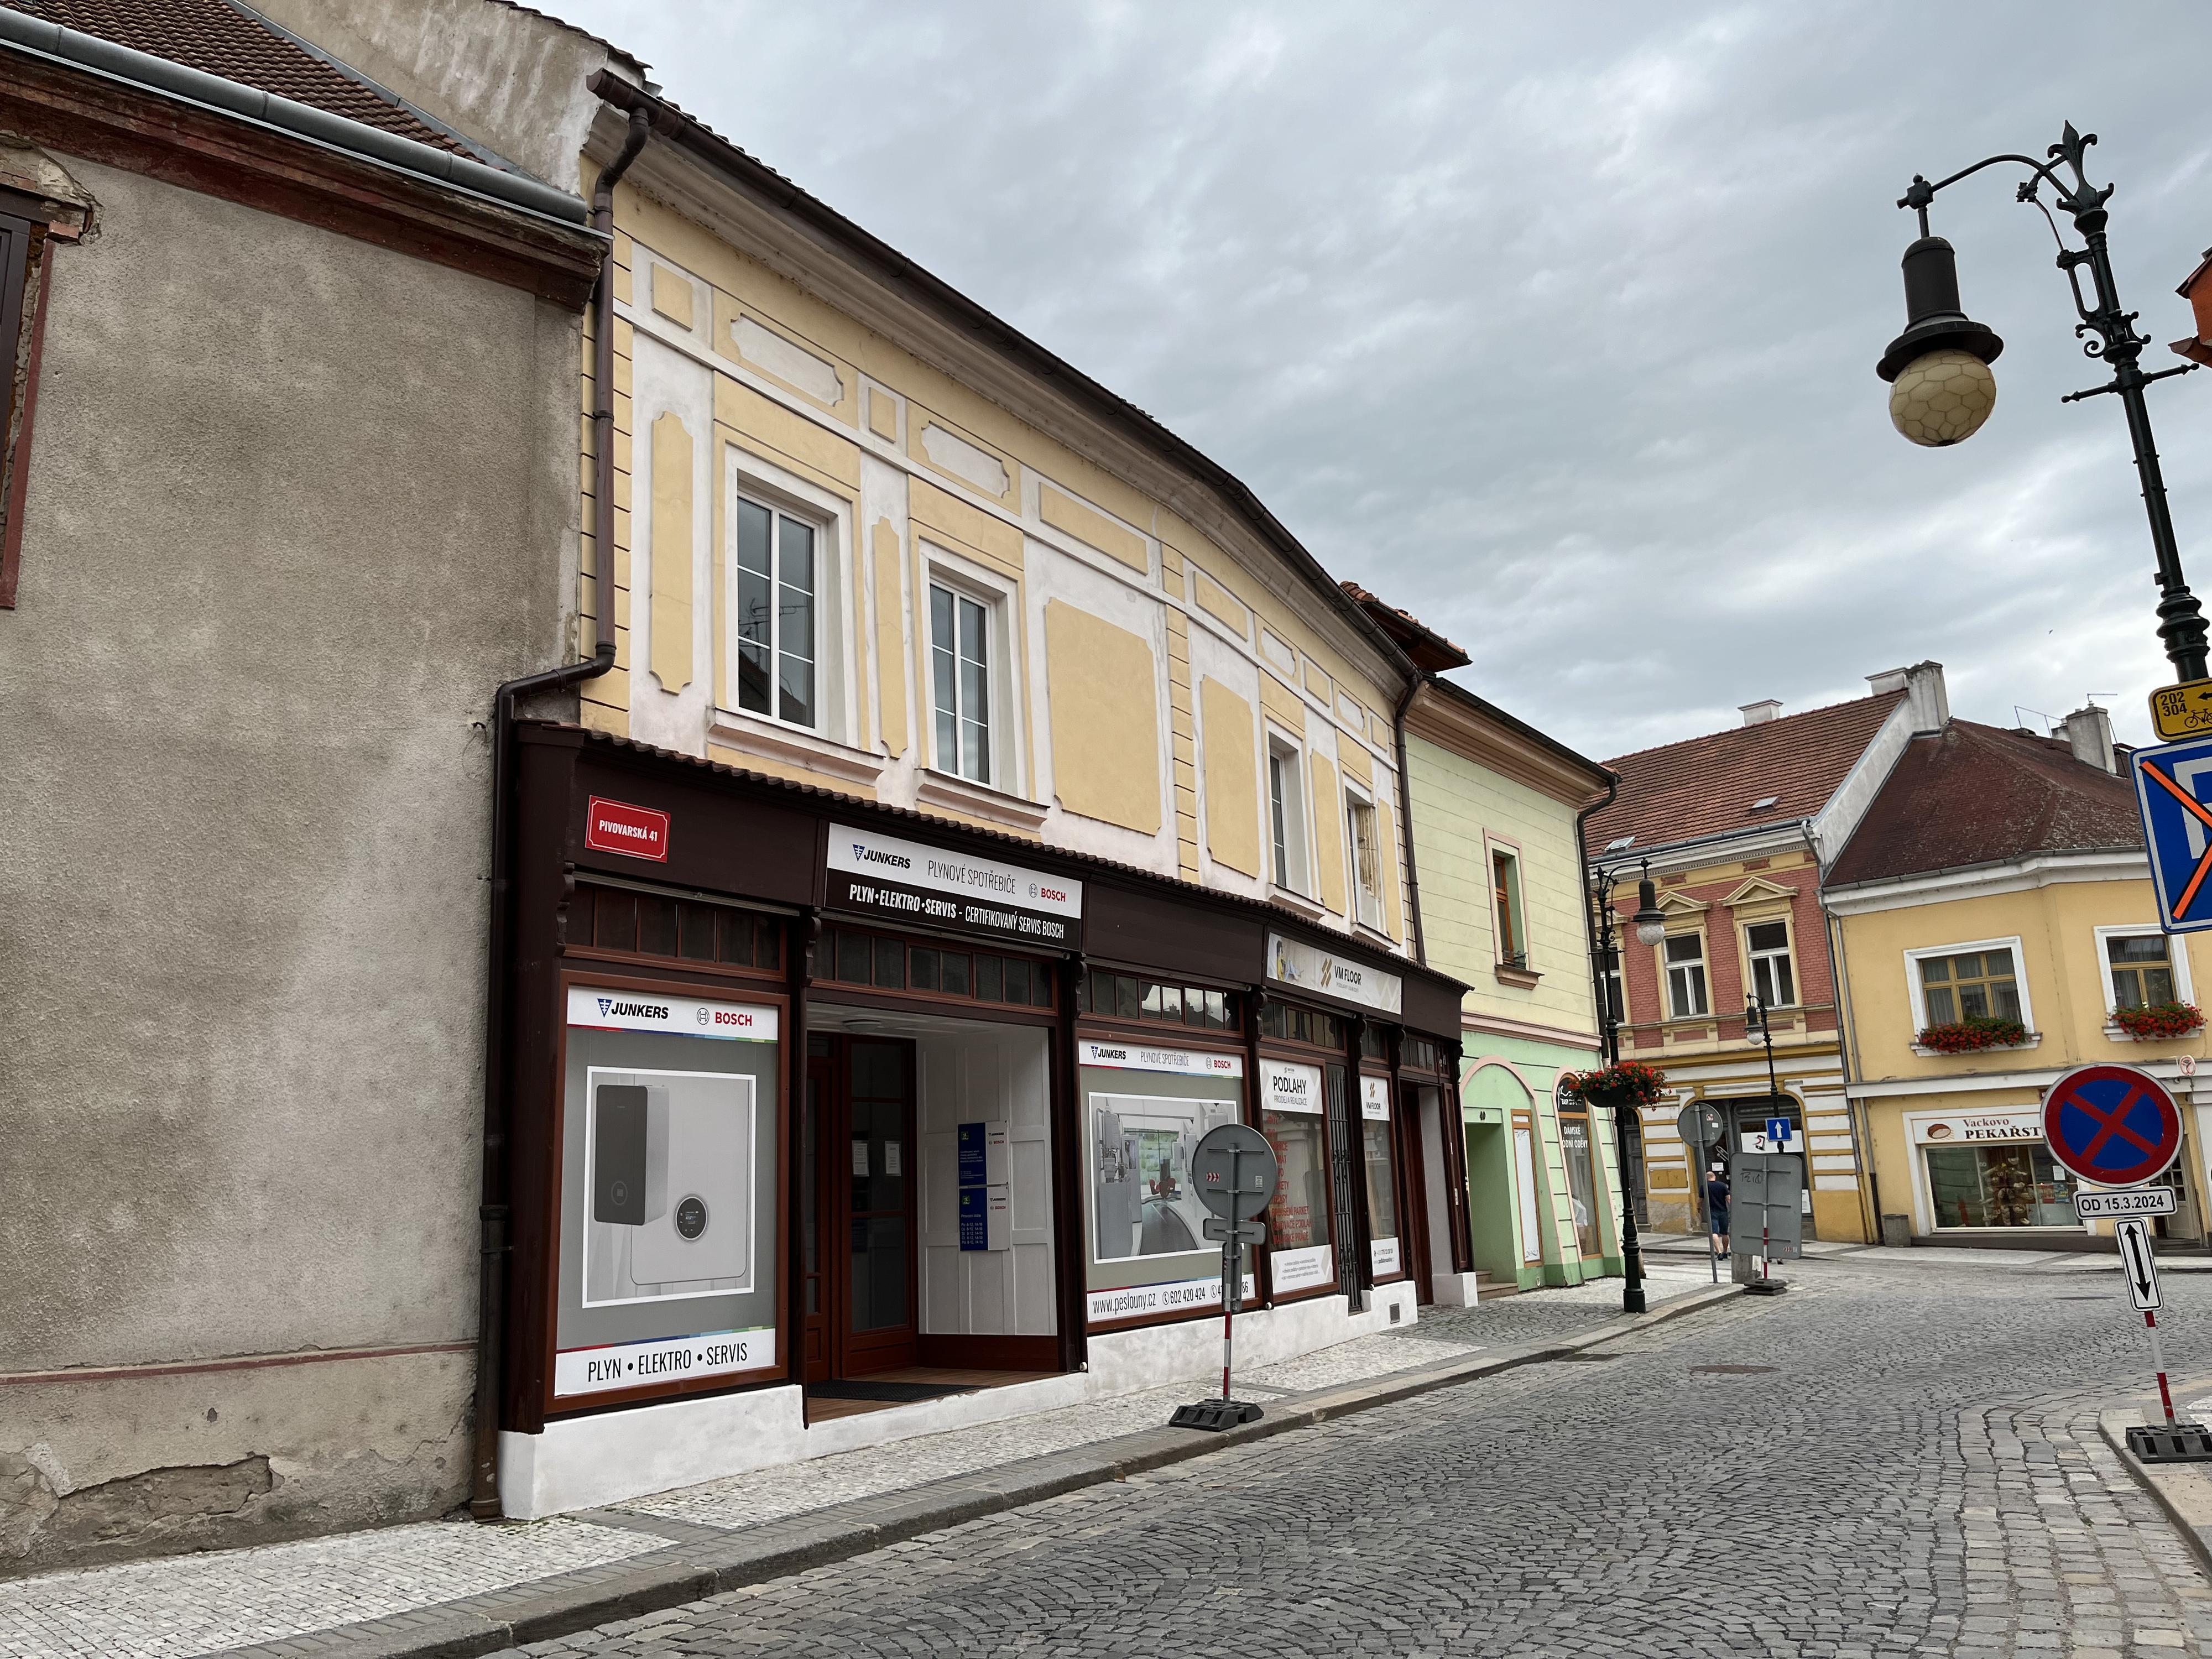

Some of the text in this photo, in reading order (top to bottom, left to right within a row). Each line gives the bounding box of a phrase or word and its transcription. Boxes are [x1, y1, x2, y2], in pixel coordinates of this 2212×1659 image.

[2160, 692, 2185, 706] 202
[2162, 703, 2188, 717] 304
[599, 820, 658, 842] PIVOVARSKÁ 41
[863, 849, 911, 869] JUNKERS
[927, 860, 1016, 894] PLYNOVÉ SPOTŘEBIČE
[1041, 888, 1066, 902] BOSCH
[849, 884, 1064, 939] PLYN ELEKTRO SERVIS CERTIFIKOVANÝ SERVIS BOSCH
[1334, 965, 1361, 985] VM FLOOR
[611, 1003, 669, 1019] JUNKERS
[715, 1012, 752, 1026] BOSCH
[1098, 1048, 1126, 1060] JUNKERS
[1140, 1051, 1189, 1066] PLYNOVÉ SPOTŘEBIČE
[1214, 1060, 1231, 1069] BOSCH
[1273, 1076, 1306, 1094] PODLAHY
[1274, 1095, 1287, 1104] PRODEJ
[1290, 1097, 1307, 1106] REALIZACE
[1480, 1111, 1485, 1120] 40
[1963, 1118, 2010, 1127] Vackovo
[1564, 1124, 1580, 1135] DÁMSKÉ
[1965, 1125, 2041, 1139] PEKAŘST
[1562, 1136, 1588, 1149] ÓDNÍ ODĚVY
[2081, 1194, 2164, 1211] OD 15.3.2024
[1093, 1292, 1156, 1315] www.peslouny.cz
[1170, 1291, 1181, 1304] 602
[1183, 1288, 1193, 1301] 420
[1195, 1287, 1206, 1300] 424
[588, 1342, 747, 1382] PLYN ELEKTRO SERVIS
